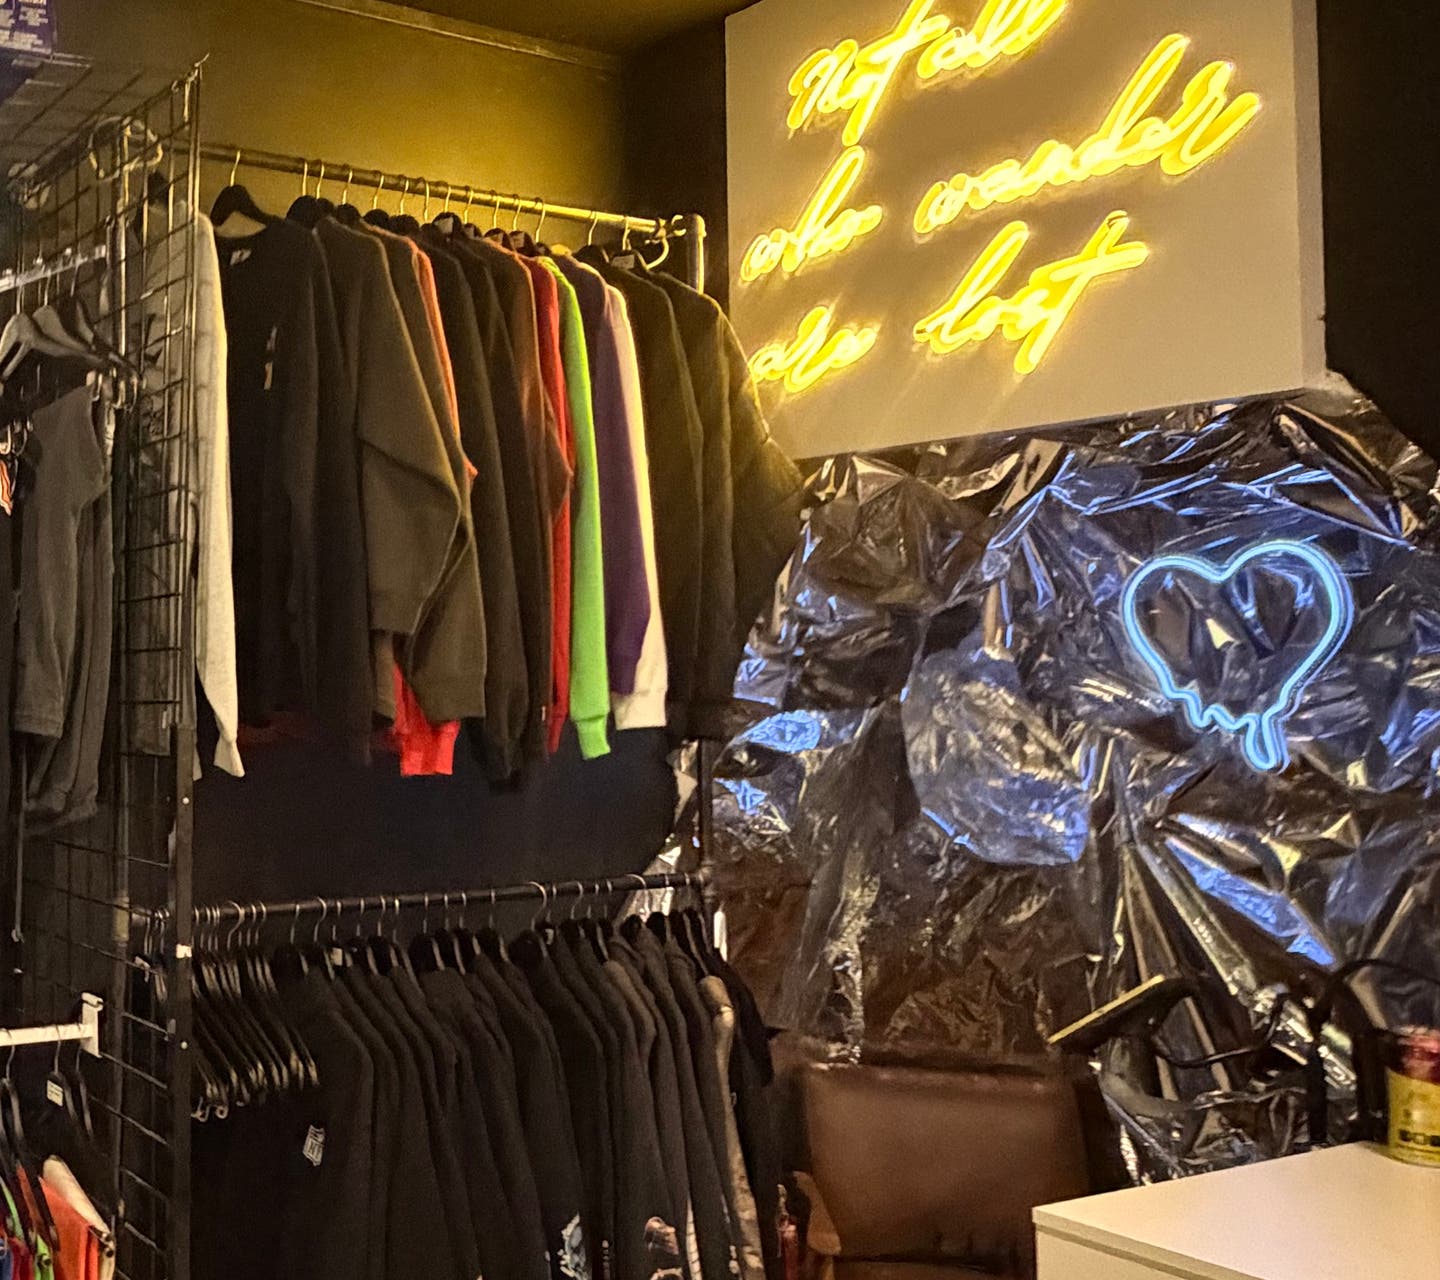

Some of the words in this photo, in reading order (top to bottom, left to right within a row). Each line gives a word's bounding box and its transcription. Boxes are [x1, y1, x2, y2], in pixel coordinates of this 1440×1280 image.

[741, 144, 884, 282] who
[914, 32, 1262, 235] wander
[914, 208, 1150, 375] lost
